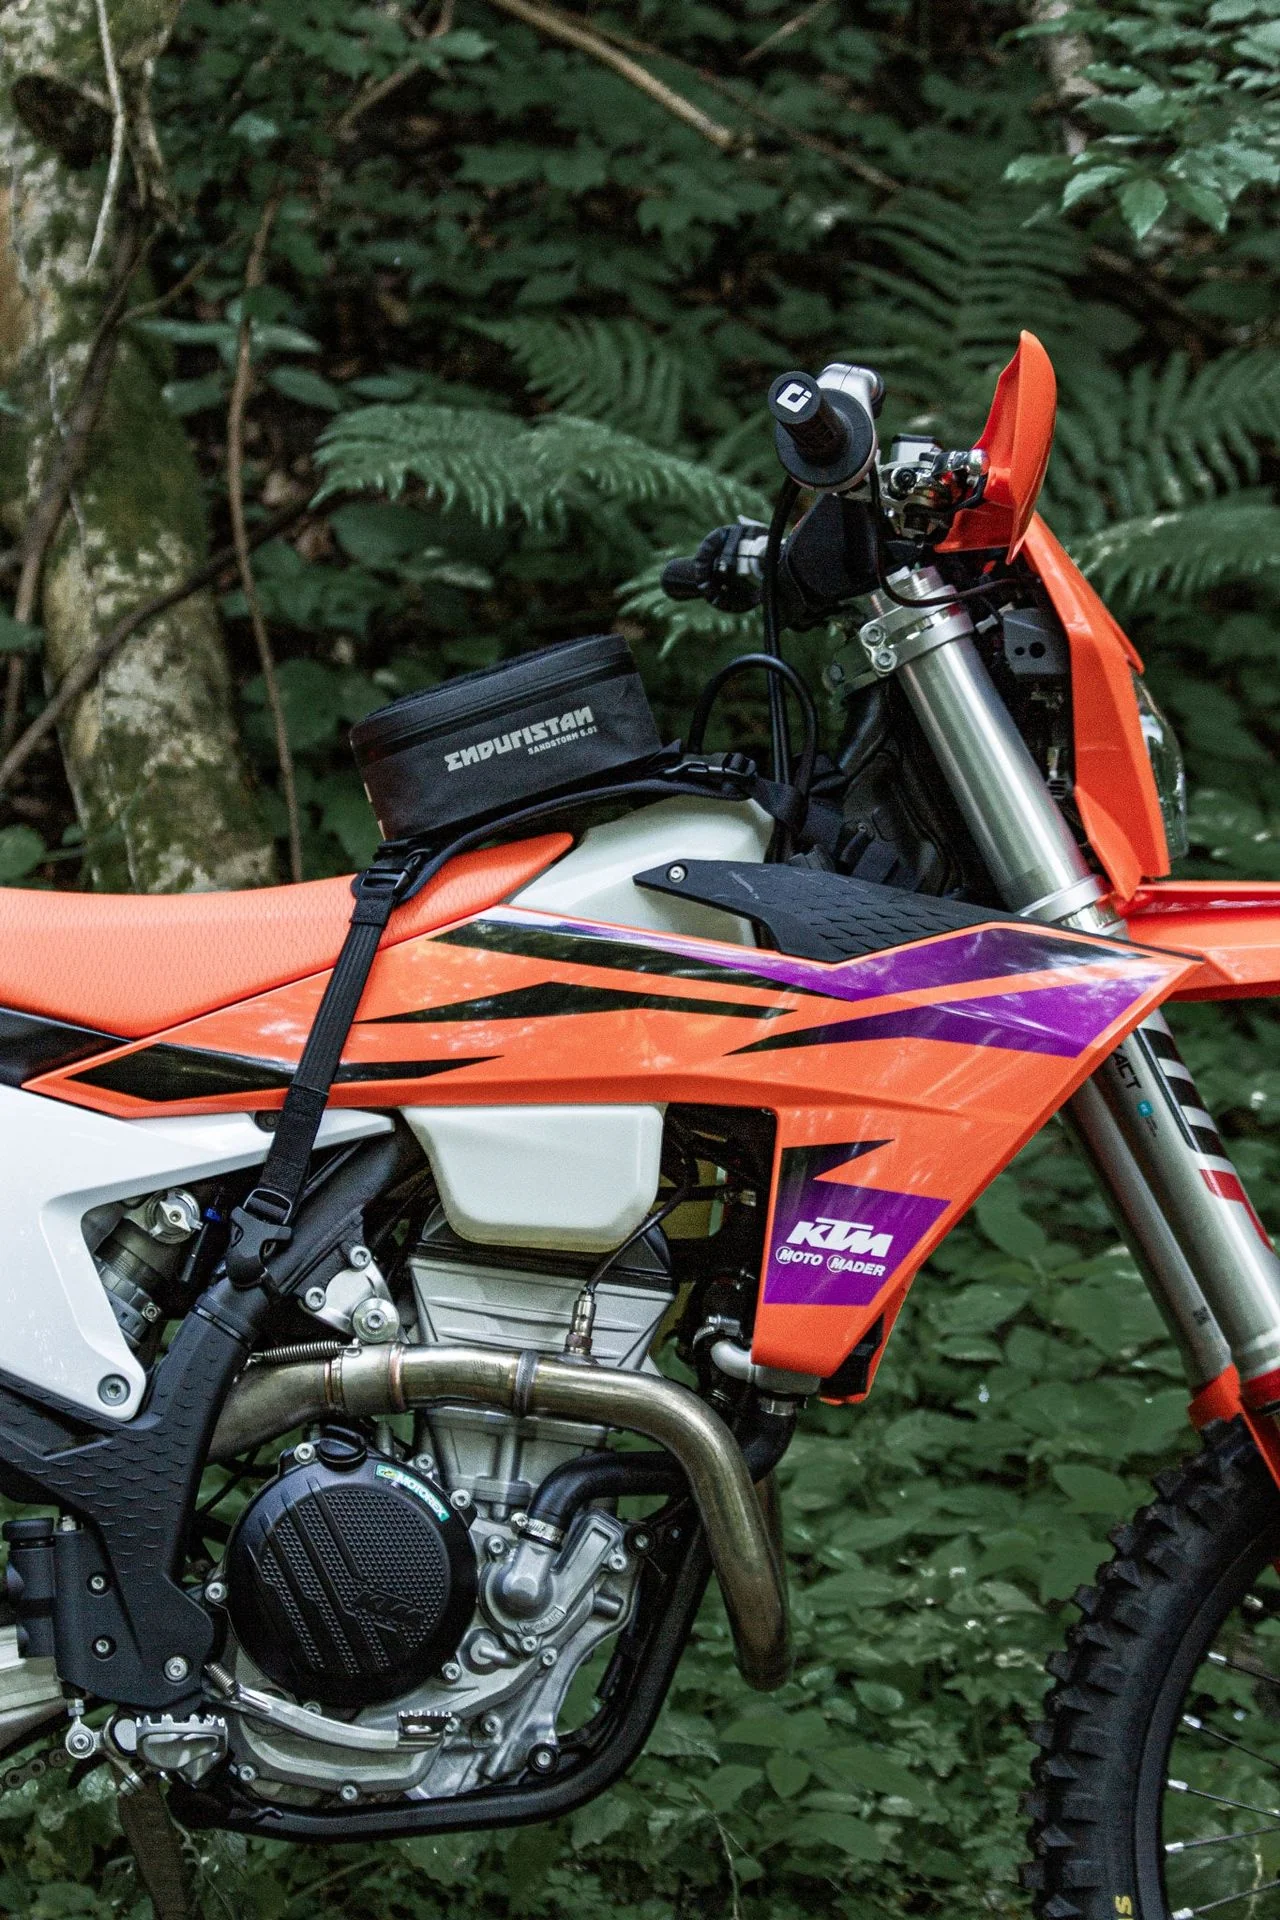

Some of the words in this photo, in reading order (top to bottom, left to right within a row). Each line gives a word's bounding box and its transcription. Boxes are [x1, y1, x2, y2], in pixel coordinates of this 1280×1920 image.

[444, 706, 594, 772] ENDURISTAN
[527, 732, 579, 755] SANDSTORM
[1111, 1044, 1142, 1088] ACT
[786, 1217, 893, 1257] KTM
[776, 1246, 823, 1265] MOTO
[827, 1255, 885, 1276] MADER
[397, 1471, 447, 1519] MOTOREX
